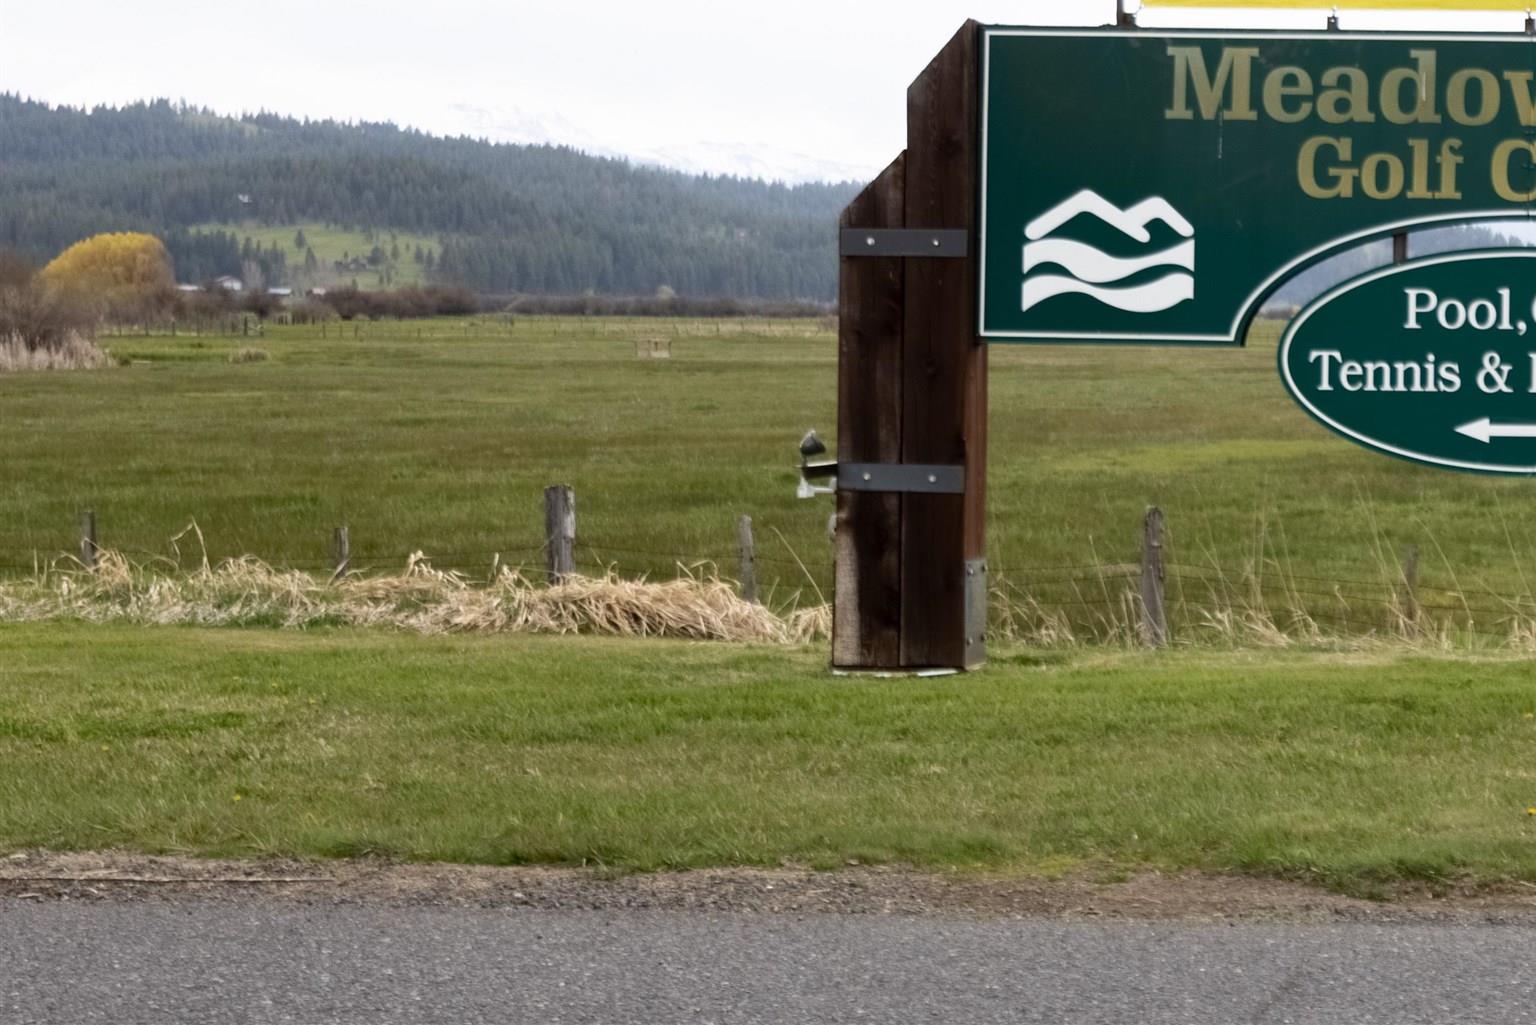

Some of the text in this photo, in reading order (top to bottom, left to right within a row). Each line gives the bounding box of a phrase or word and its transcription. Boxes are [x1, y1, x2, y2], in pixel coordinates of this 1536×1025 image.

[1297, 136, 1465, 202] Golf
[1308, 349, 1462, 393] Tennis
[1476, 351, 1514, 394] &
